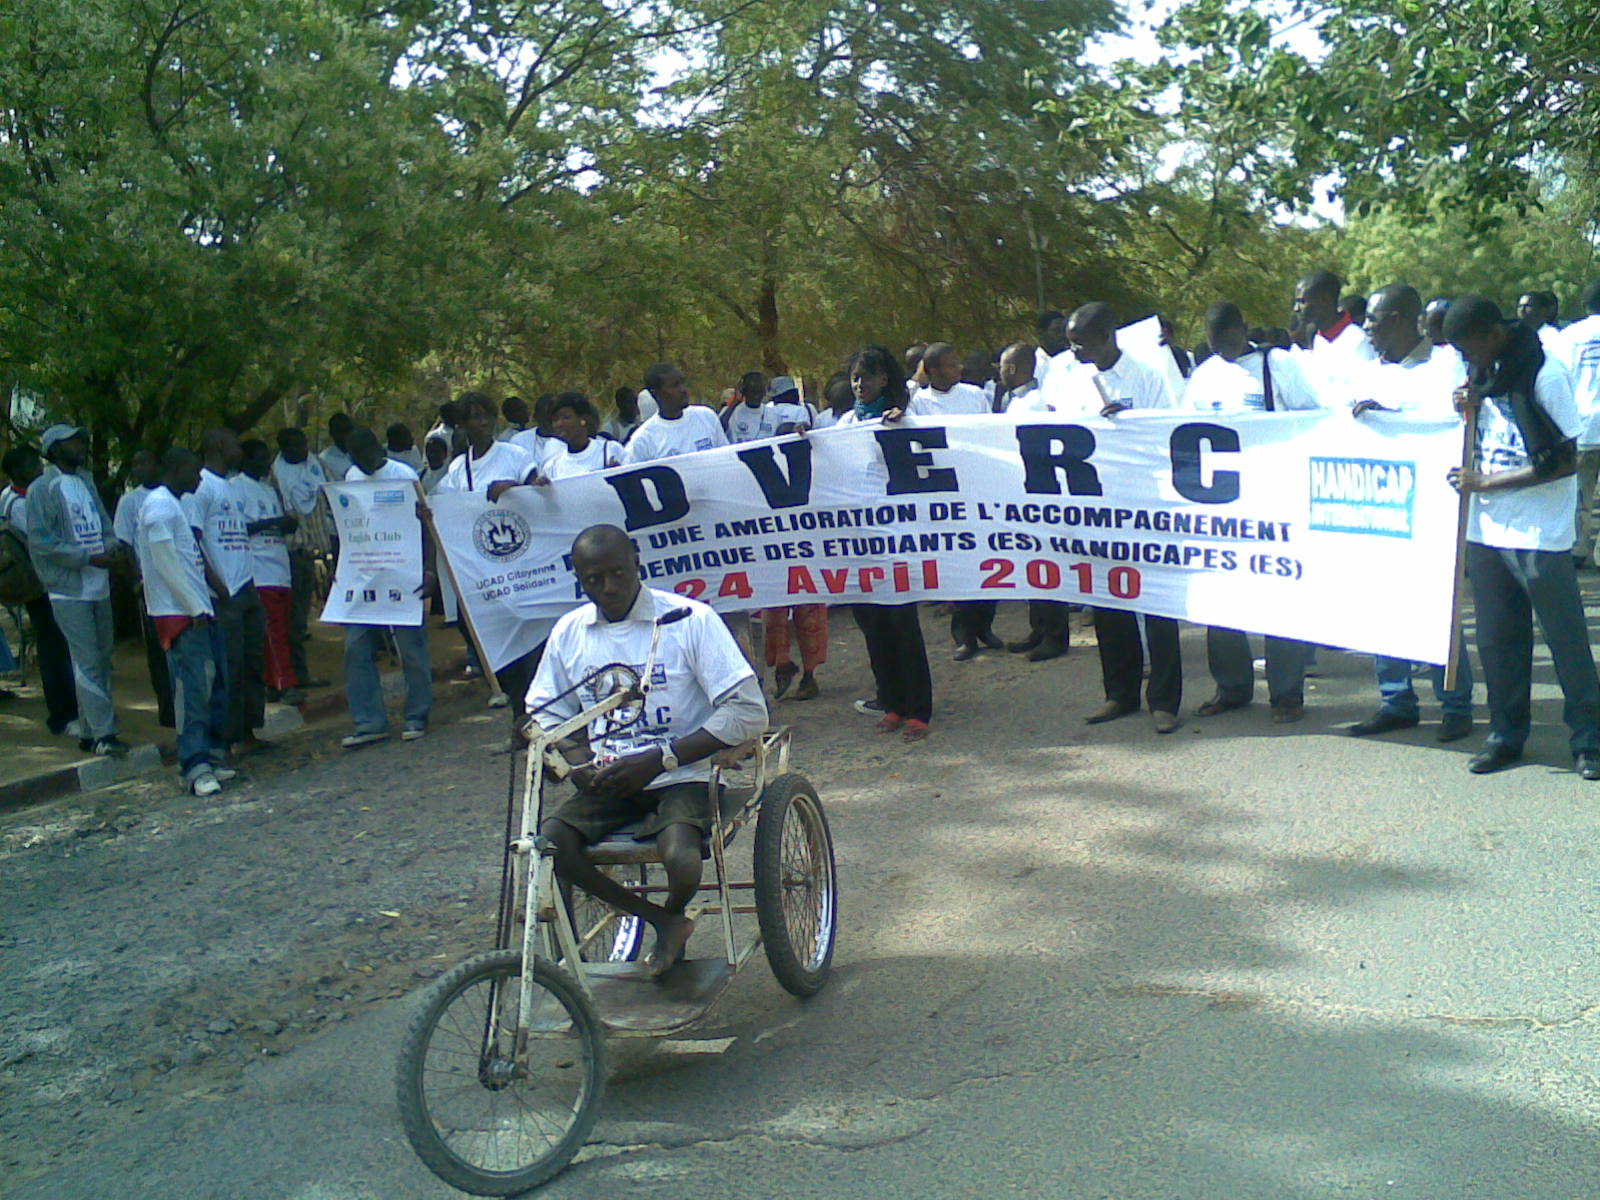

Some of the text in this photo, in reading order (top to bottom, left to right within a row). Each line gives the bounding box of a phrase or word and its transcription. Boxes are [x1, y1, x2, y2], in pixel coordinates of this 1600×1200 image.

[1312, 462, 1412, 503] HANDICAP
[374, 531, 402, 542] Club
[649, 525, 705, 549] UNE
[715, 503, 917, 538] AMELIORATION
[929, 502, 967, 521] DE
[978, 502, 1292, 542] L'ACCOMPAGNEMENT
[764, 540, 815, 561] DES
[823, 532, 977, 557] ETUDIANTS
[988, 532, 1042, 552] (ES)
[1050, 536, 1237, 570] HANDICAPES
[1249, 554, 1303, 580] (ES)
[476, 564, 556, 590] UCAD Citoyenne
[482, 576, 556, 601] UCAD Solidaire
[674, 558, 1141, 605] 24 Avril 2010
